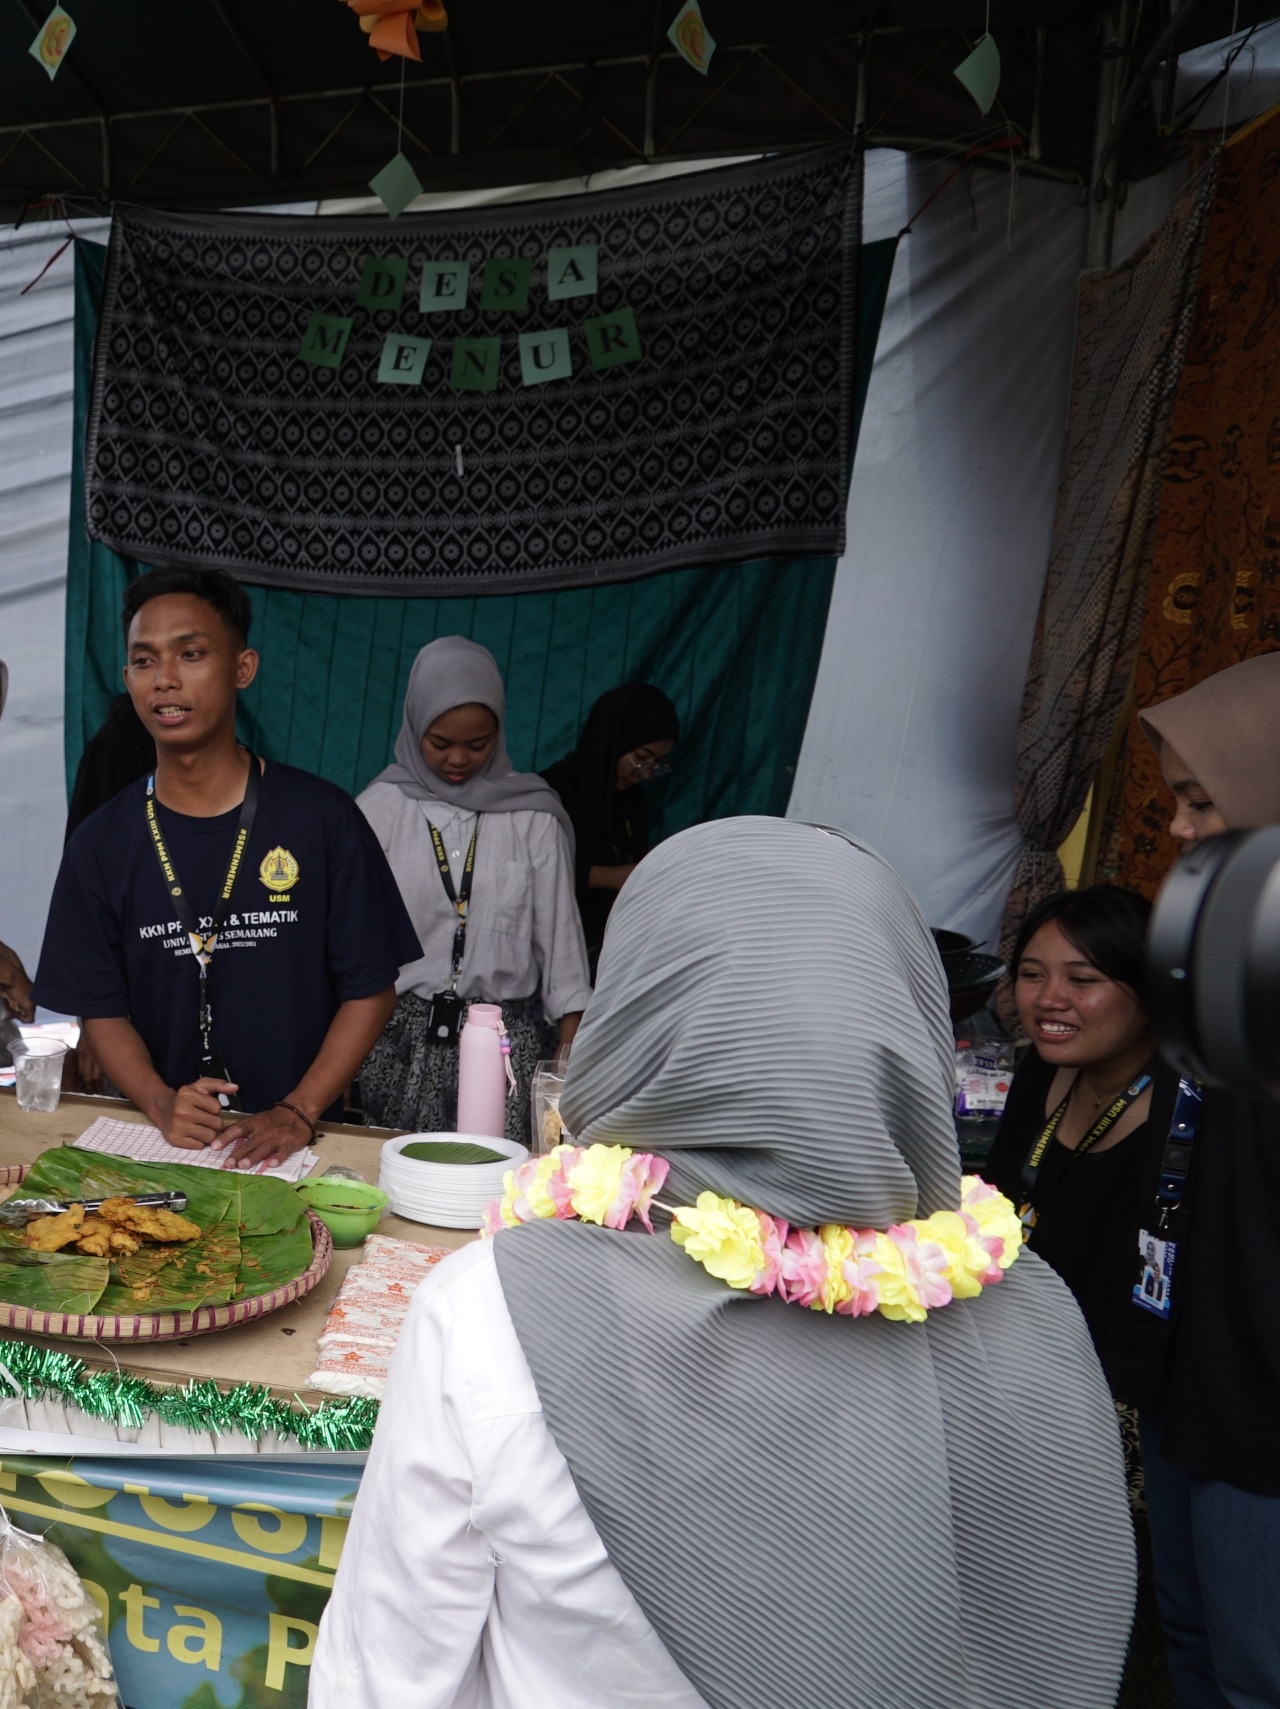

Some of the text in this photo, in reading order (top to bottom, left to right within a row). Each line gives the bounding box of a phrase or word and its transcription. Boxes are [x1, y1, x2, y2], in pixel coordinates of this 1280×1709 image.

[369, 257, 586, 298] DESA
[309, 322, 631, 379] MENUR
[146, 799, 176, 882] KKN PPM XXIII USM
[221, 828, 248, 899] #SEMENMENUR
[269, 894, 291, 903] USM
[139, 922, 166, 939] KKN
[229, 913, 240, 926] &
[241, 910, 299, 925] TEMATIK
[224, 928, 277, 940] SEMARANG
[1091, 1117, 1113, 1137] XXIII
[1106, 1098, 1128, 1119] USM
